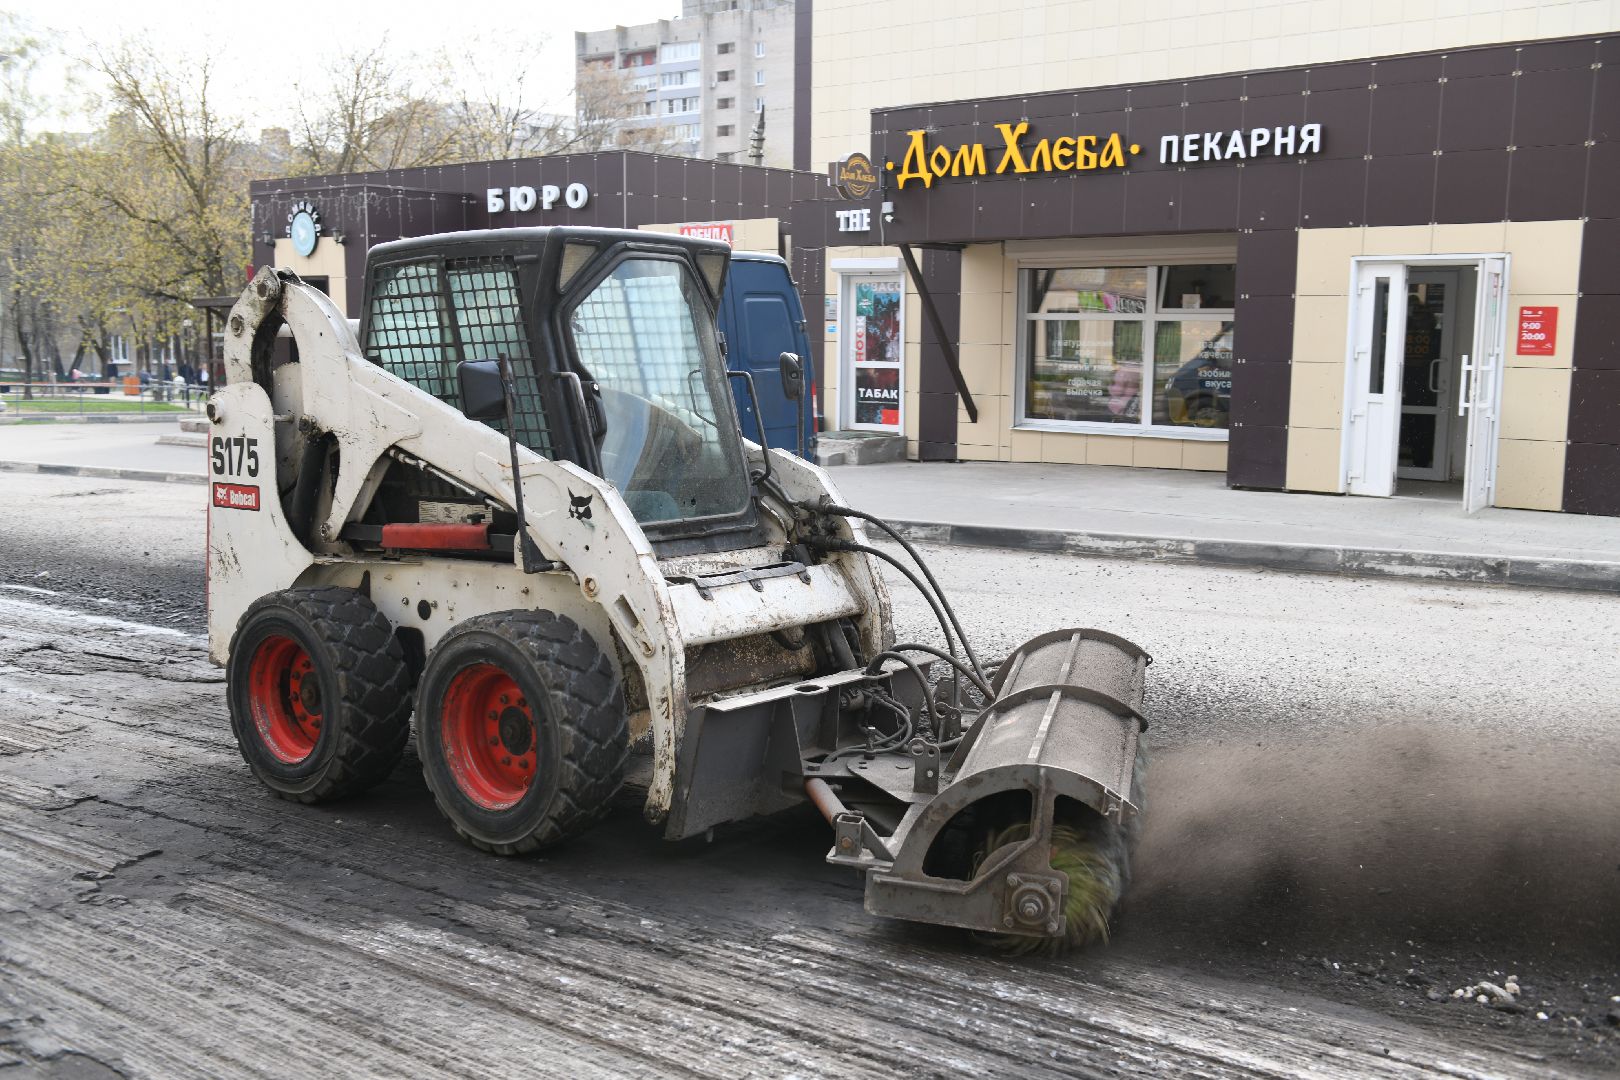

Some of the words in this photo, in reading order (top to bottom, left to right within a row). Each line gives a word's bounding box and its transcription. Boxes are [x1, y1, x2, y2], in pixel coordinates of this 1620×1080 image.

[1159, 123, 1321, 164] ПЕКАРНЯ
[486, 182, 588, 213] БЮРО
[858, 387, 898, 399] ТАБАК
[1066, 388, 1103, 397] выпечка
[211, 436, 259, 477] S175
[229, 489, 256, 507] Bobcat
